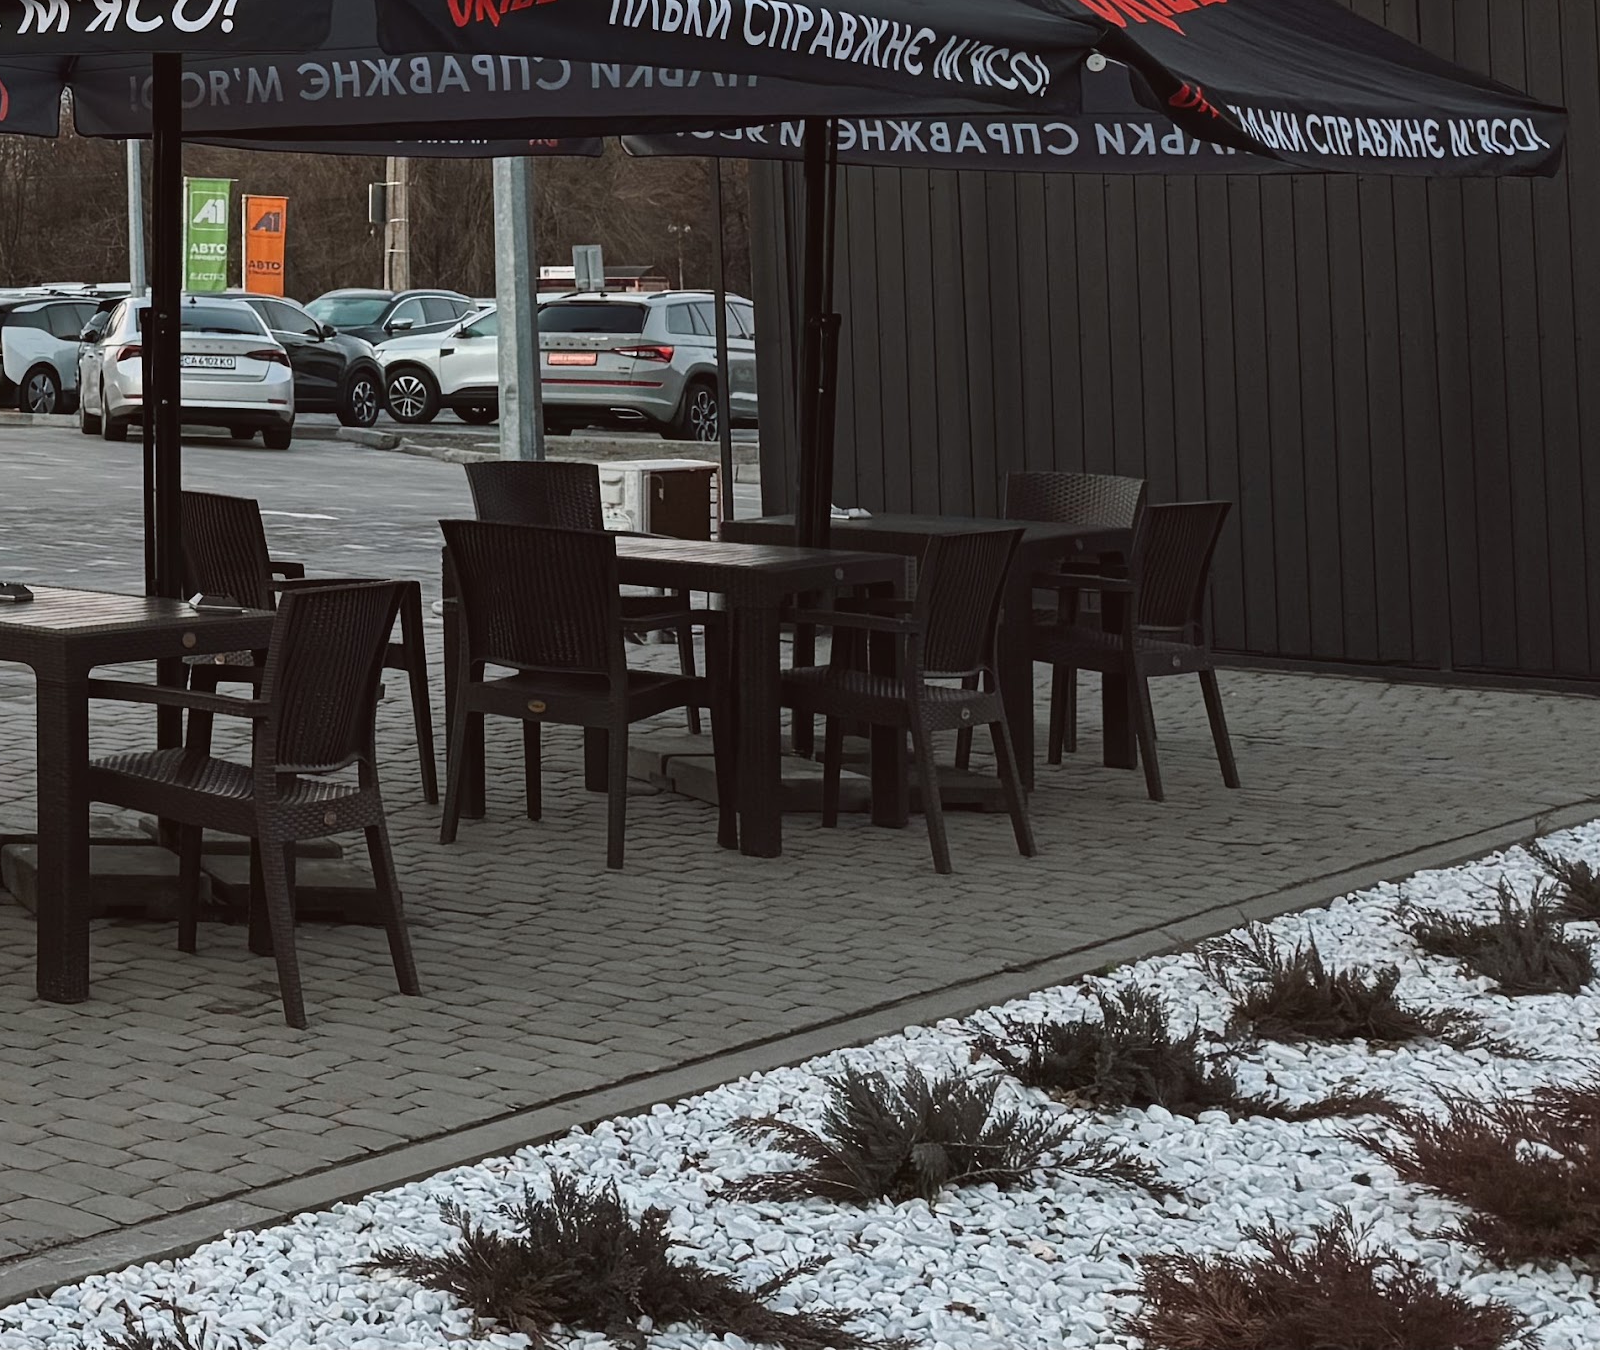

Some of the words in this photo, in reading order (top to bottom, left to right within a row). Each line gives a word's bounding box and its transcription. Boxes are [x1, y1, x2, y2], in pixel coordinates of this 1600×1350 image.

[1226, 104, 1309, 152] ІЛЬКИ
[1305, 113, 1445, 159] СПРАВЖНЄ
[193, 198, 226, 225] A1
[251, 211, 281, 233] A1
[190, 242, 228, 255] АВТО
[248, 260, 281, 270] АВТО
